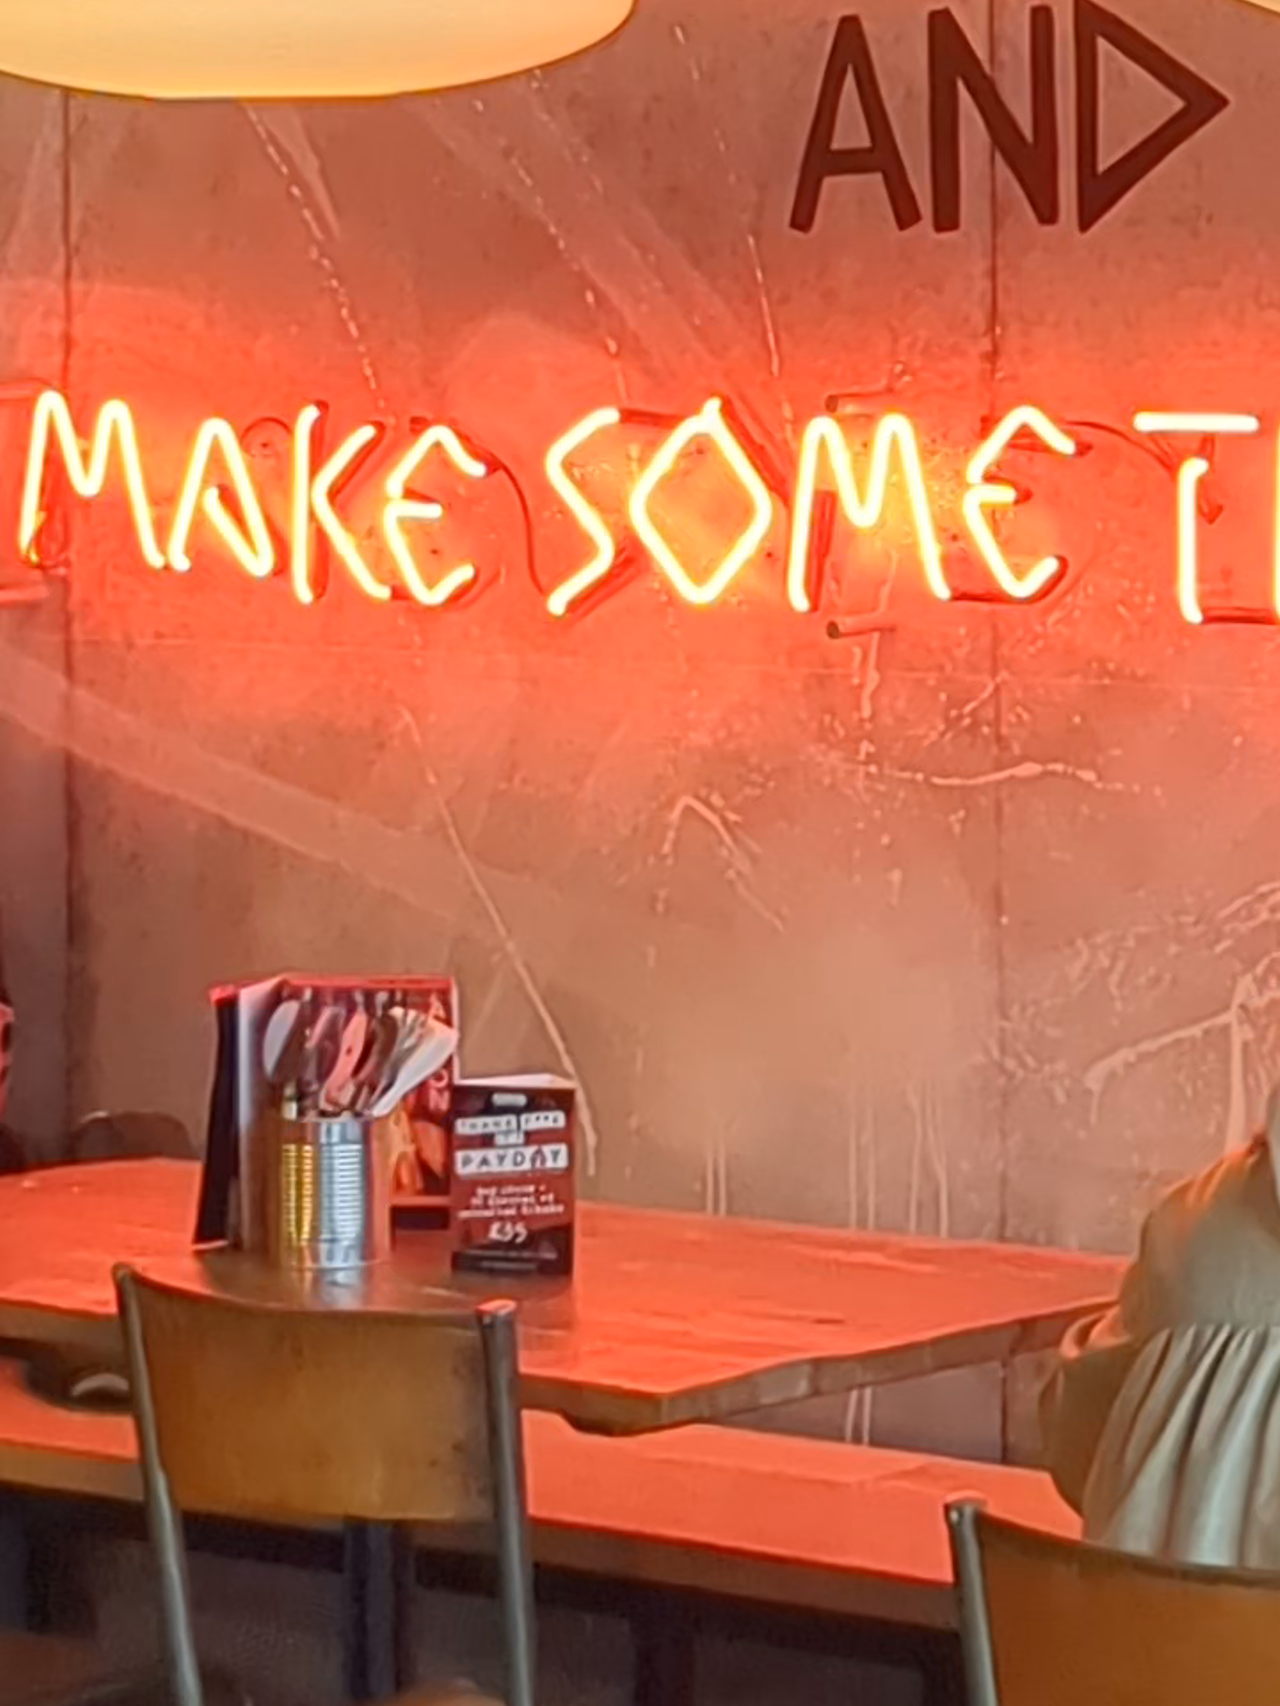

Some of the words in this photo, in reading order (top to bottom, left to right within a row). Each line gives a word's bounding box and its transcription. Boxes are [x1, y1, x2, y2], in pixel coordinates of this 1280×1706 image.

[18, 390, 489, 607] MAKE
[544, 397, 1077, 615] SOME
[460, 1145, 562, 1172] PAYDAY
